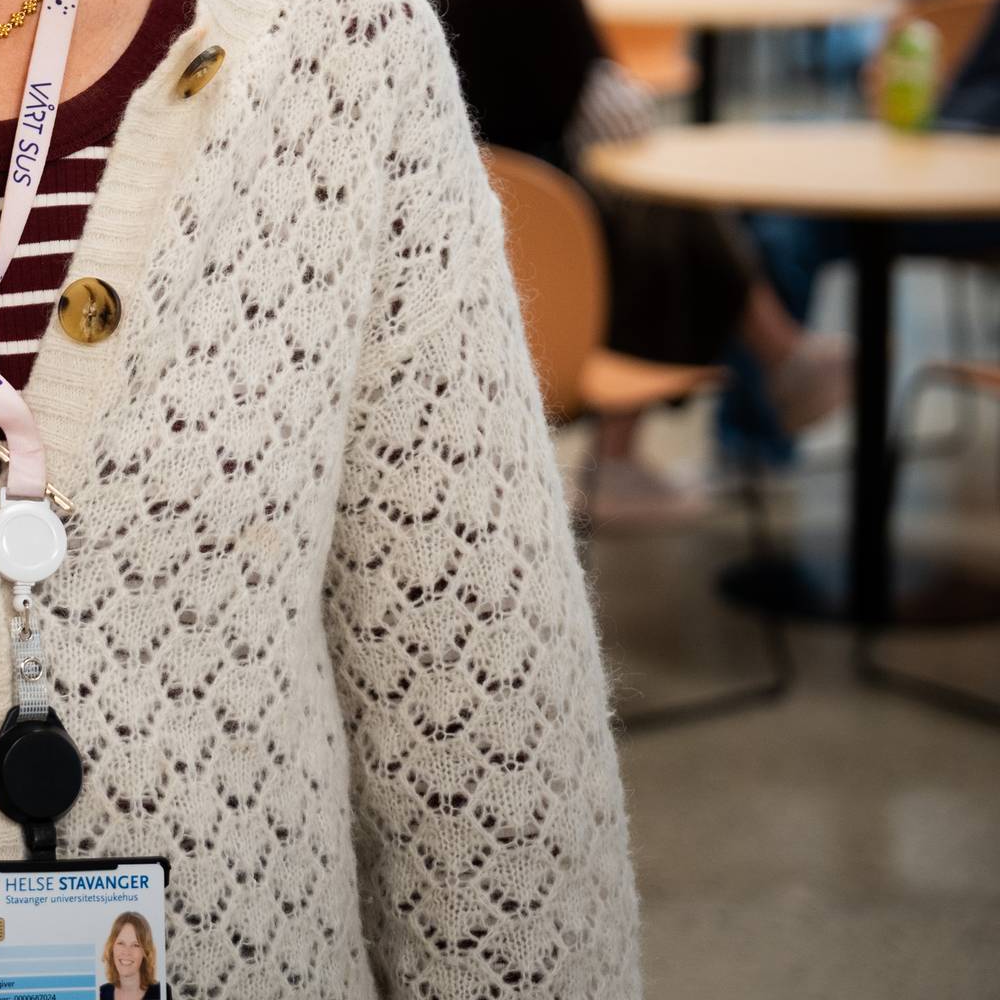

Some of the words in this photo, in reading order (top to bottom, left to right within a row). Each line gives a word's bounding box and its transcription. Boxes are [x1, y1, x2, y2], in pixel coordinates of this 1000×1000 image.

[22, 82, 55, 135] VÅRT
[12, 139, 39, 187] SUS
[5, 877, 54, 892] HELSE
[58, 875, 149, 891] STAVANGER
[6, 895, 48, 906] Stavanger
[50, 893, 139, 904] universitetssjukehus
